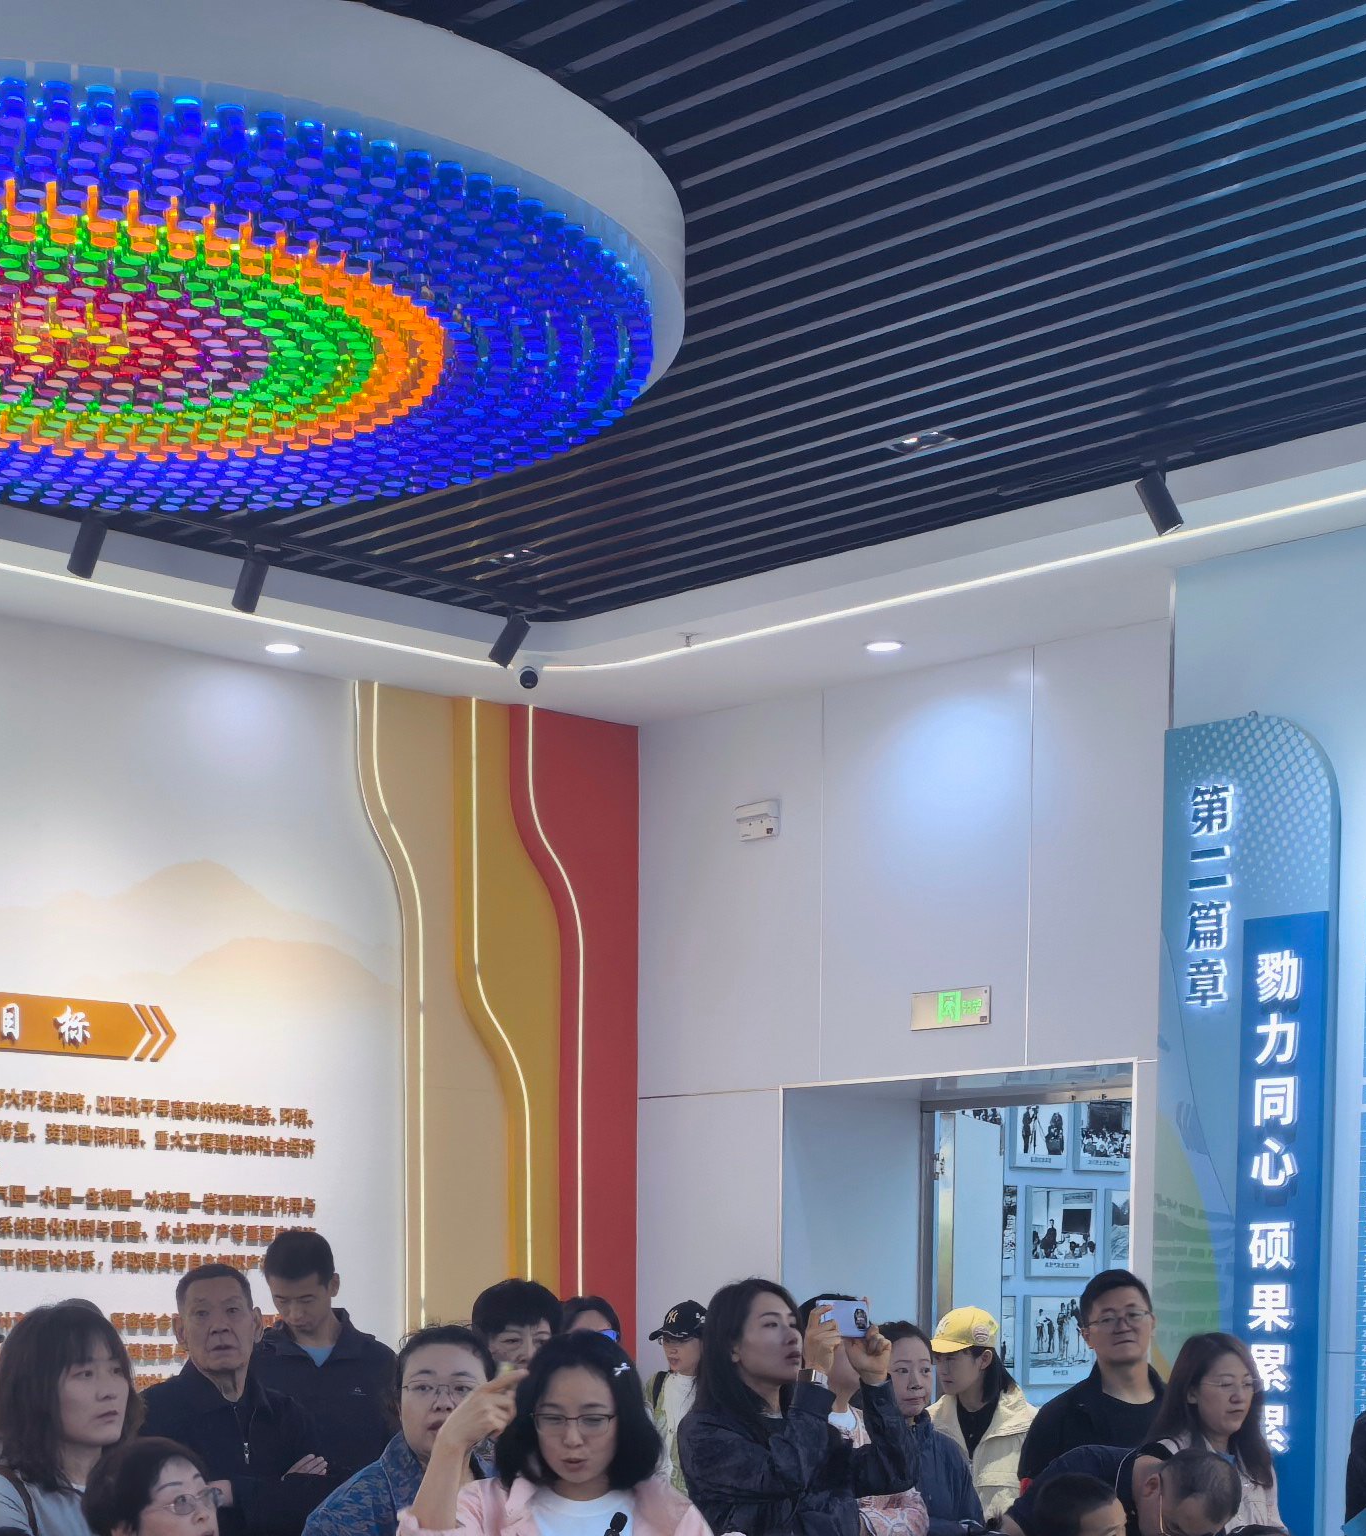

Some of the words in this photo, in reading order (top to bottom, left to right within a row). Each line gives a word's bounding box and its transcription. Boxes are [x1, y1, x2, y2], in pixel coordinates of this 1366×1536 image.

[1186, 784, 1233, 1008] 第二篇章
[0, 1001, 94, 1049] 目标
[1250, 950, 1302, 1189] 勠力同心
[1247, 1221, 1295, 1453] 硕果累累
